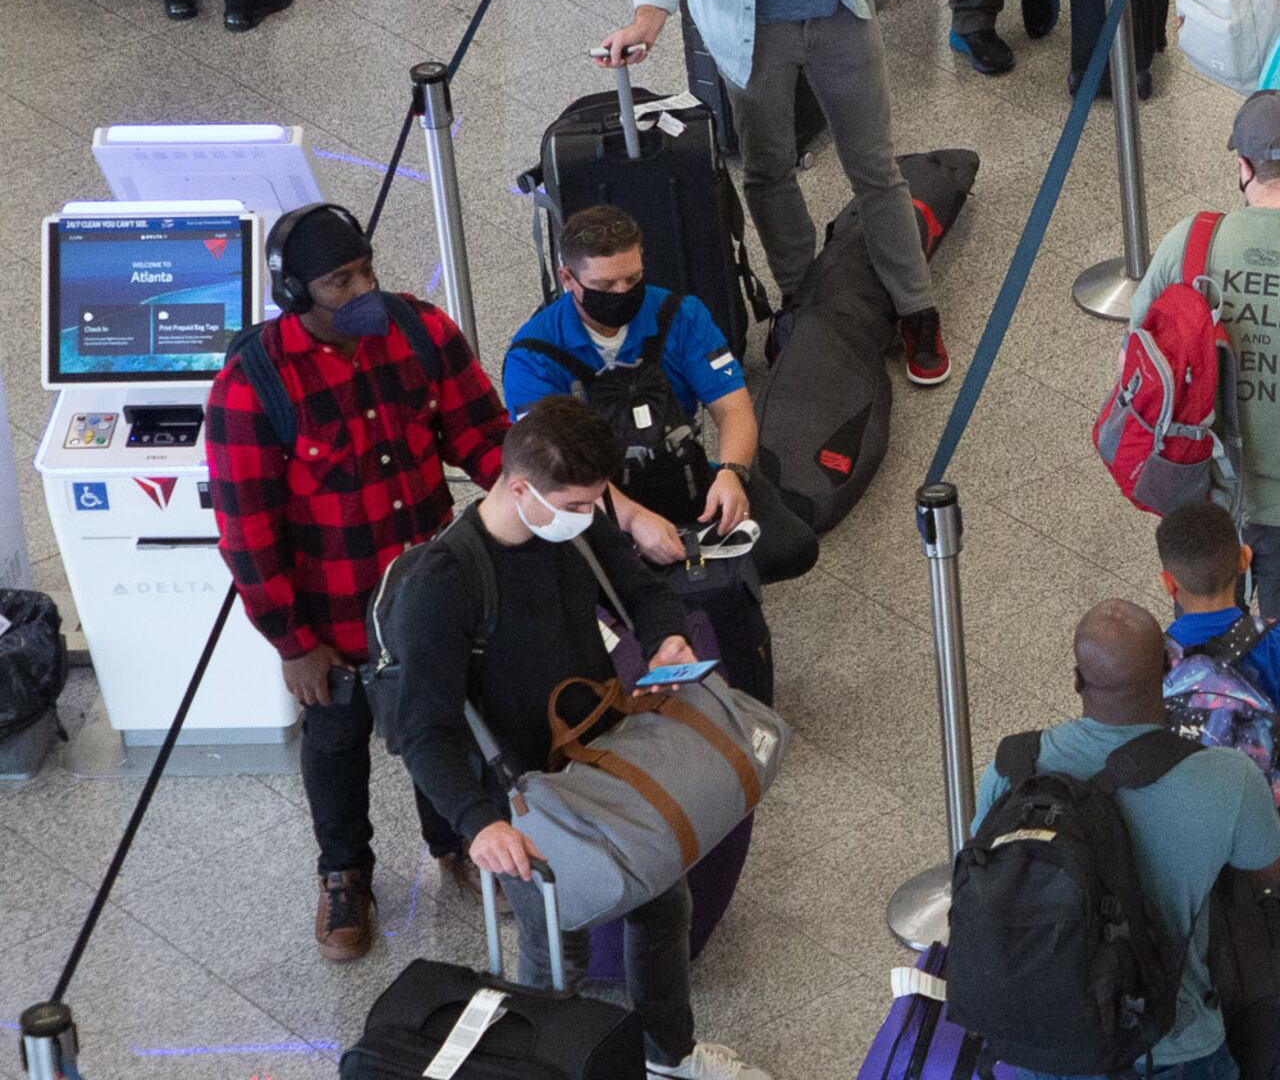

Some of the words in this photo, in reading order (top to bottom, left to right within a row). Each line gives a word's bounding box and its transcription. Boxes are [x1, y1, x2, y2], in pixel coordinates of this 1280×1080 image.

[81, 220, 101, 228] CLEAN
[102, 220, 115, 228] YOU
[116, 220, 134, 228] CAN'T
[131, 271, 173, 283] Atlanta
[1241, 333, 1272, 345] AND
[1236, 380, 1276, 403] ON
[137, 581, 215, 594] DELTA
